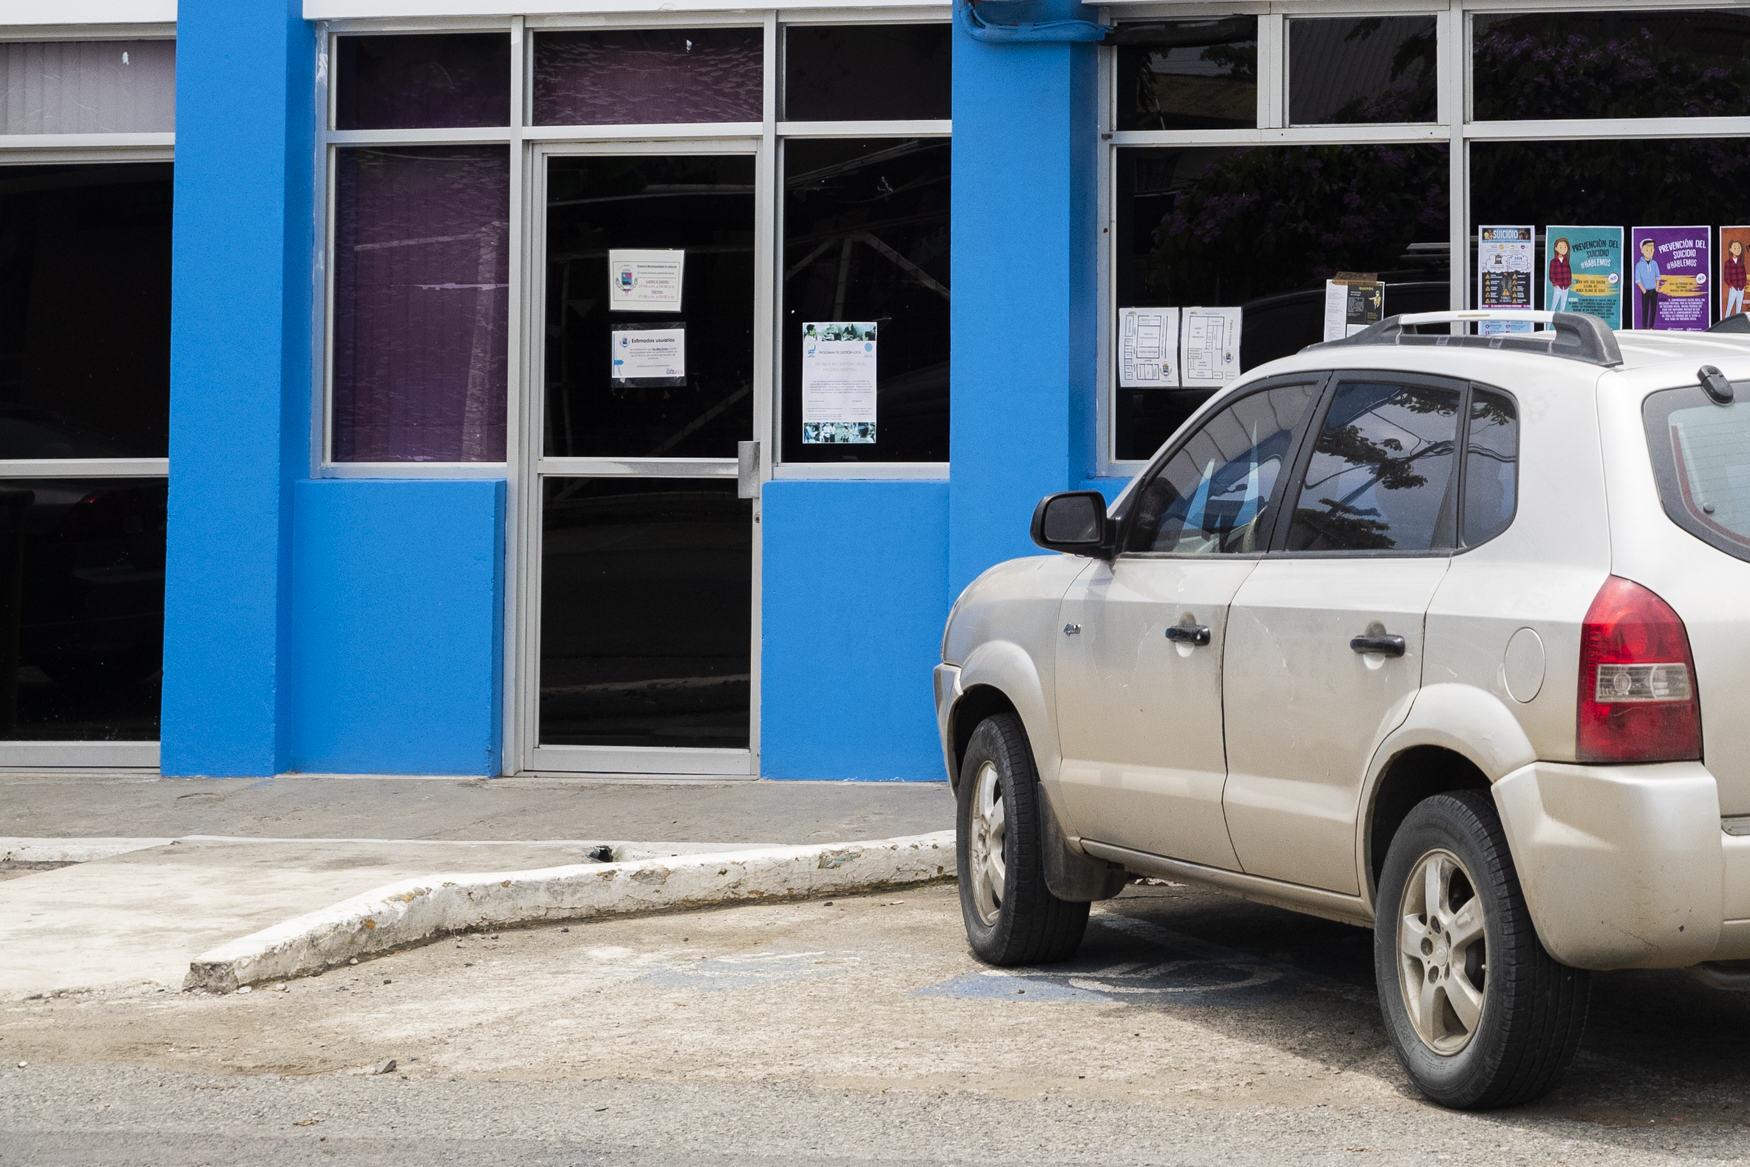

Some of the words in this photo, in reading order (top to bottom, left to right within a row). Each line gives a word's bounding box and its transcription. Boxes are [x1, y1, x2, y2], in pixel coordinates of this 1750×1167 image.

[1493, 229, 1519, 239] SUICIDIO
[1571, 238, 1607, 253] PREVENCIÓN
[1608, 239, 1619, 249] DEL
[1658, 238, 1693, 254] PREVENCIÓN
[1695, 239, 1706, 249] DEL
[1586, 249, 1610, 259] SUICIDIO
[1672, 249, 1697, 259] SUICIDIO
[1580, 258, 1611, 269] #HABLEMOS
[1666, 258, 1698, 270] #HABLEMOS
